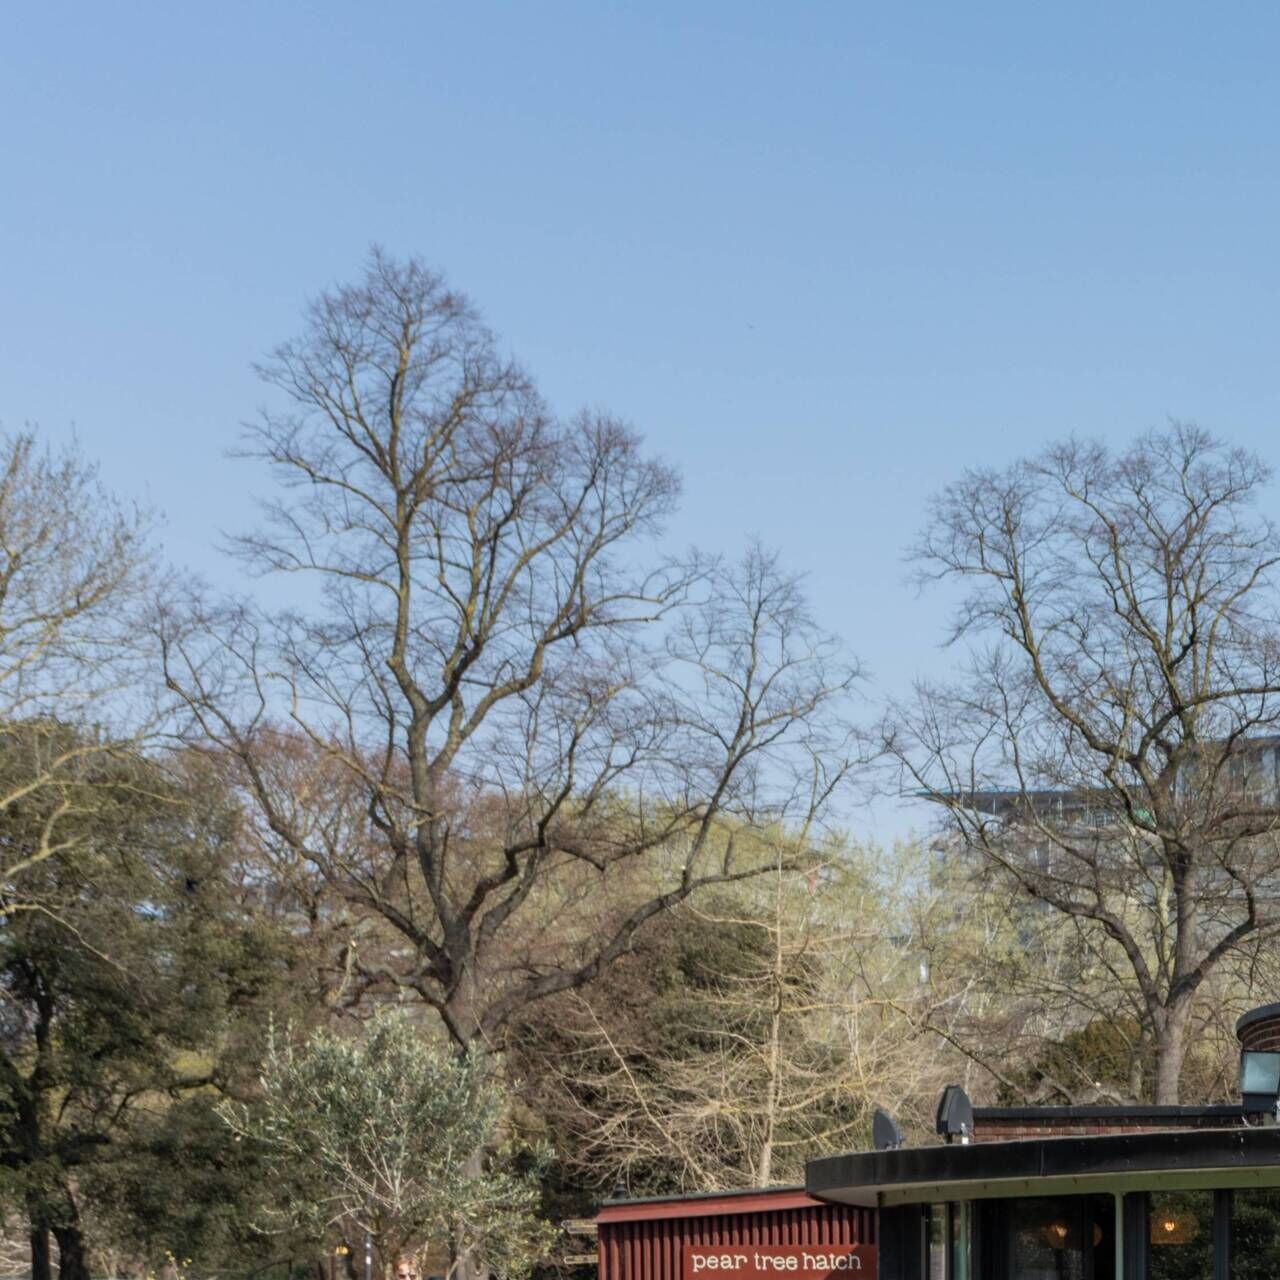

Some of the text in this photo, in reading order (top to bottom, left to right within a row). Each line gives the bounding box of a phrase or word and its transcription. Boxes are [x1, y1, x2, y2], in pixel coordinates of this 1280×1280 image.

[691, 1252, 862, 1272] pear tree hatch
